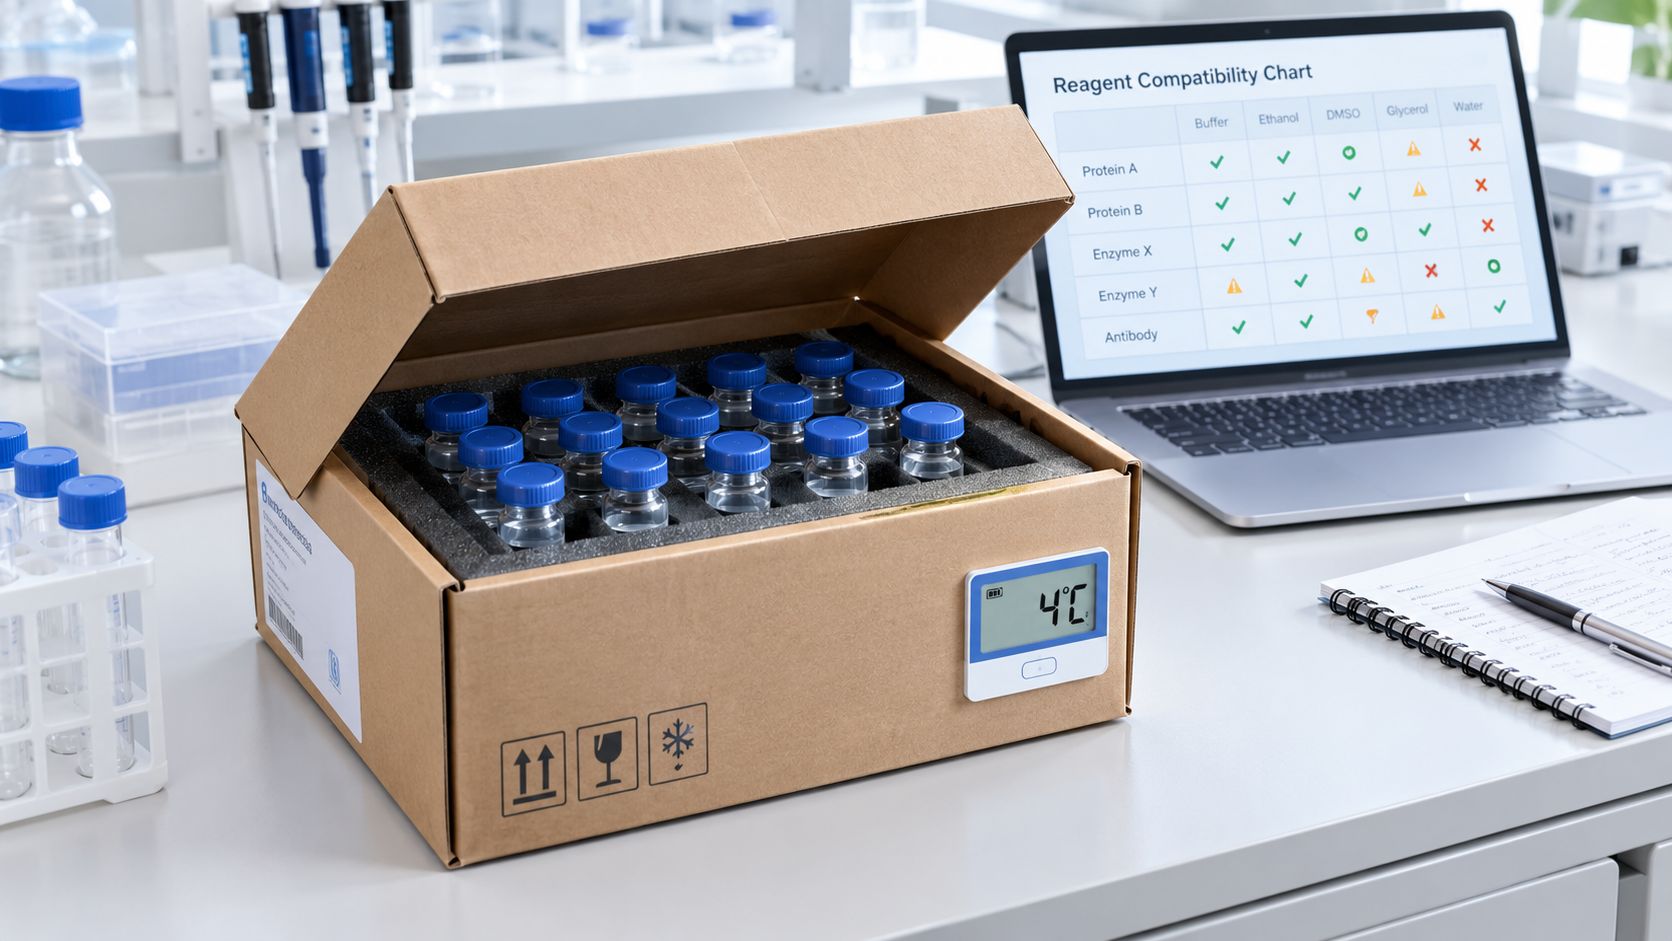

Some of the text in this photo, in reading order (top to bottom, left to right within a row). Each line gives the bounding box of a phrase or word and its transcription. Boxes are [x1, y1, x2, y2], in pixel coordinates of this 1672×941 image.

[1053, 64, 1313, 96] Reagent Compatibility Chart
[1326, 107, 1361, 121] DMSO
[1386, 103, 1429, 118] Glycerol
[1453, 101, 1484, 113] Water
[1195, 116, 1229, 129] Buffer
[1258, 111, 1300, 125] Ethanol
[1083, 163, 1138, 177] Protein A
[1088, 204, 1143, 219] Protein B
[1093, 245, 1153, 262] Enzyme X
[1099, 286, 1158, 304] Enzyme Y
[1105, 328, 1158, 343] Antibody
[1040, 583, 1088, 626] 4°C
